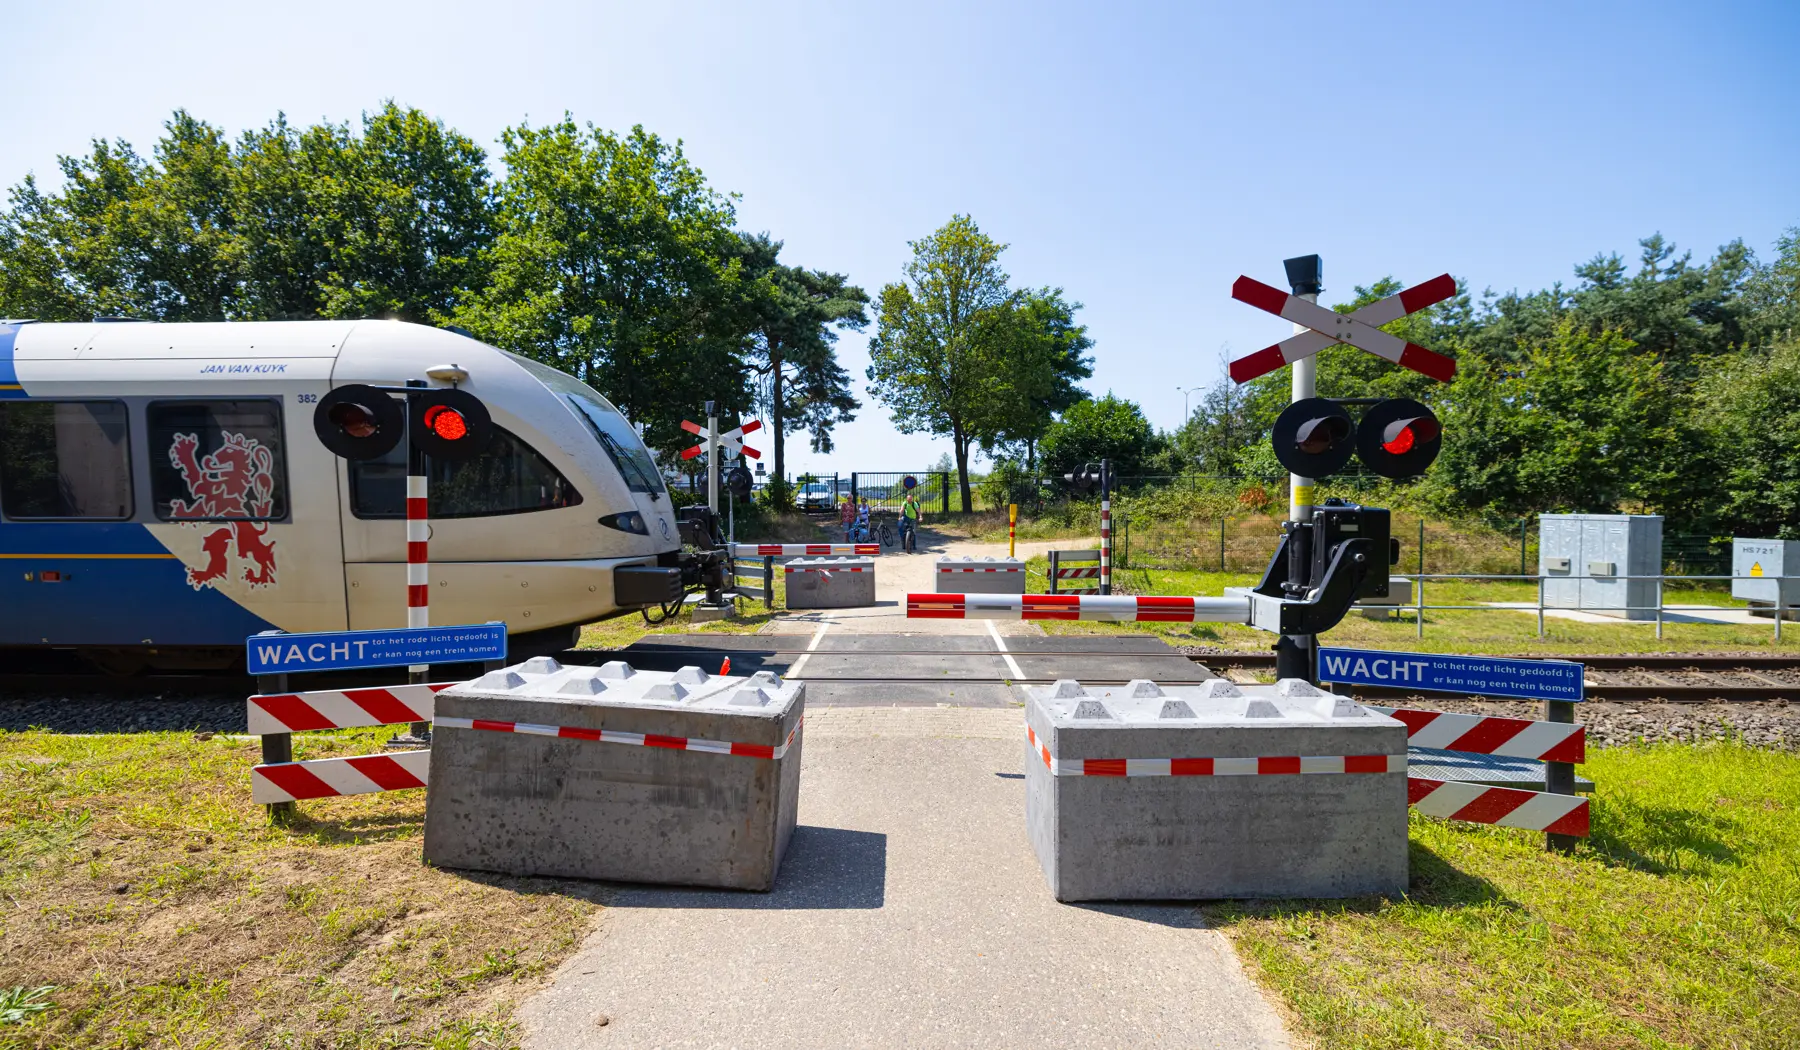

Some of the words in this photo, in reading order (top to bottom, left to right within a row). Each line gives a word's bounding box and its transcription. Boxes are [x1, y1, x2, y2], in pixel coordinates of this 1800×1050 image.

[200, 365, 226, 373] JAN
[228, 364, 252, 373] VAN
[252, 364, 288, 373] KUYK
[297, 394, 318, 403] 382
[407, 636, 428, 644] rode
[454, 633, 488, 643] gedoofd
[257, 641, 369, 665] WACHT
[385, 650, 402, 658] kan
[1325, 656, 1429, 682] WACHT
[1450, 662, 1466, 671] het
[1468, 664, 1491, 672] rode
[1494, 665, 1517, 674] licht
[1519, 668, 1563, 677] gedoofd
[1565, 669, 1574, 678] is
[1446, 676, 1464, 685] kan
[1467, 680, 1486, 688] nog
[1510, 682, 1536, 690] trein
[1539, 683, 1575, 693] komen
